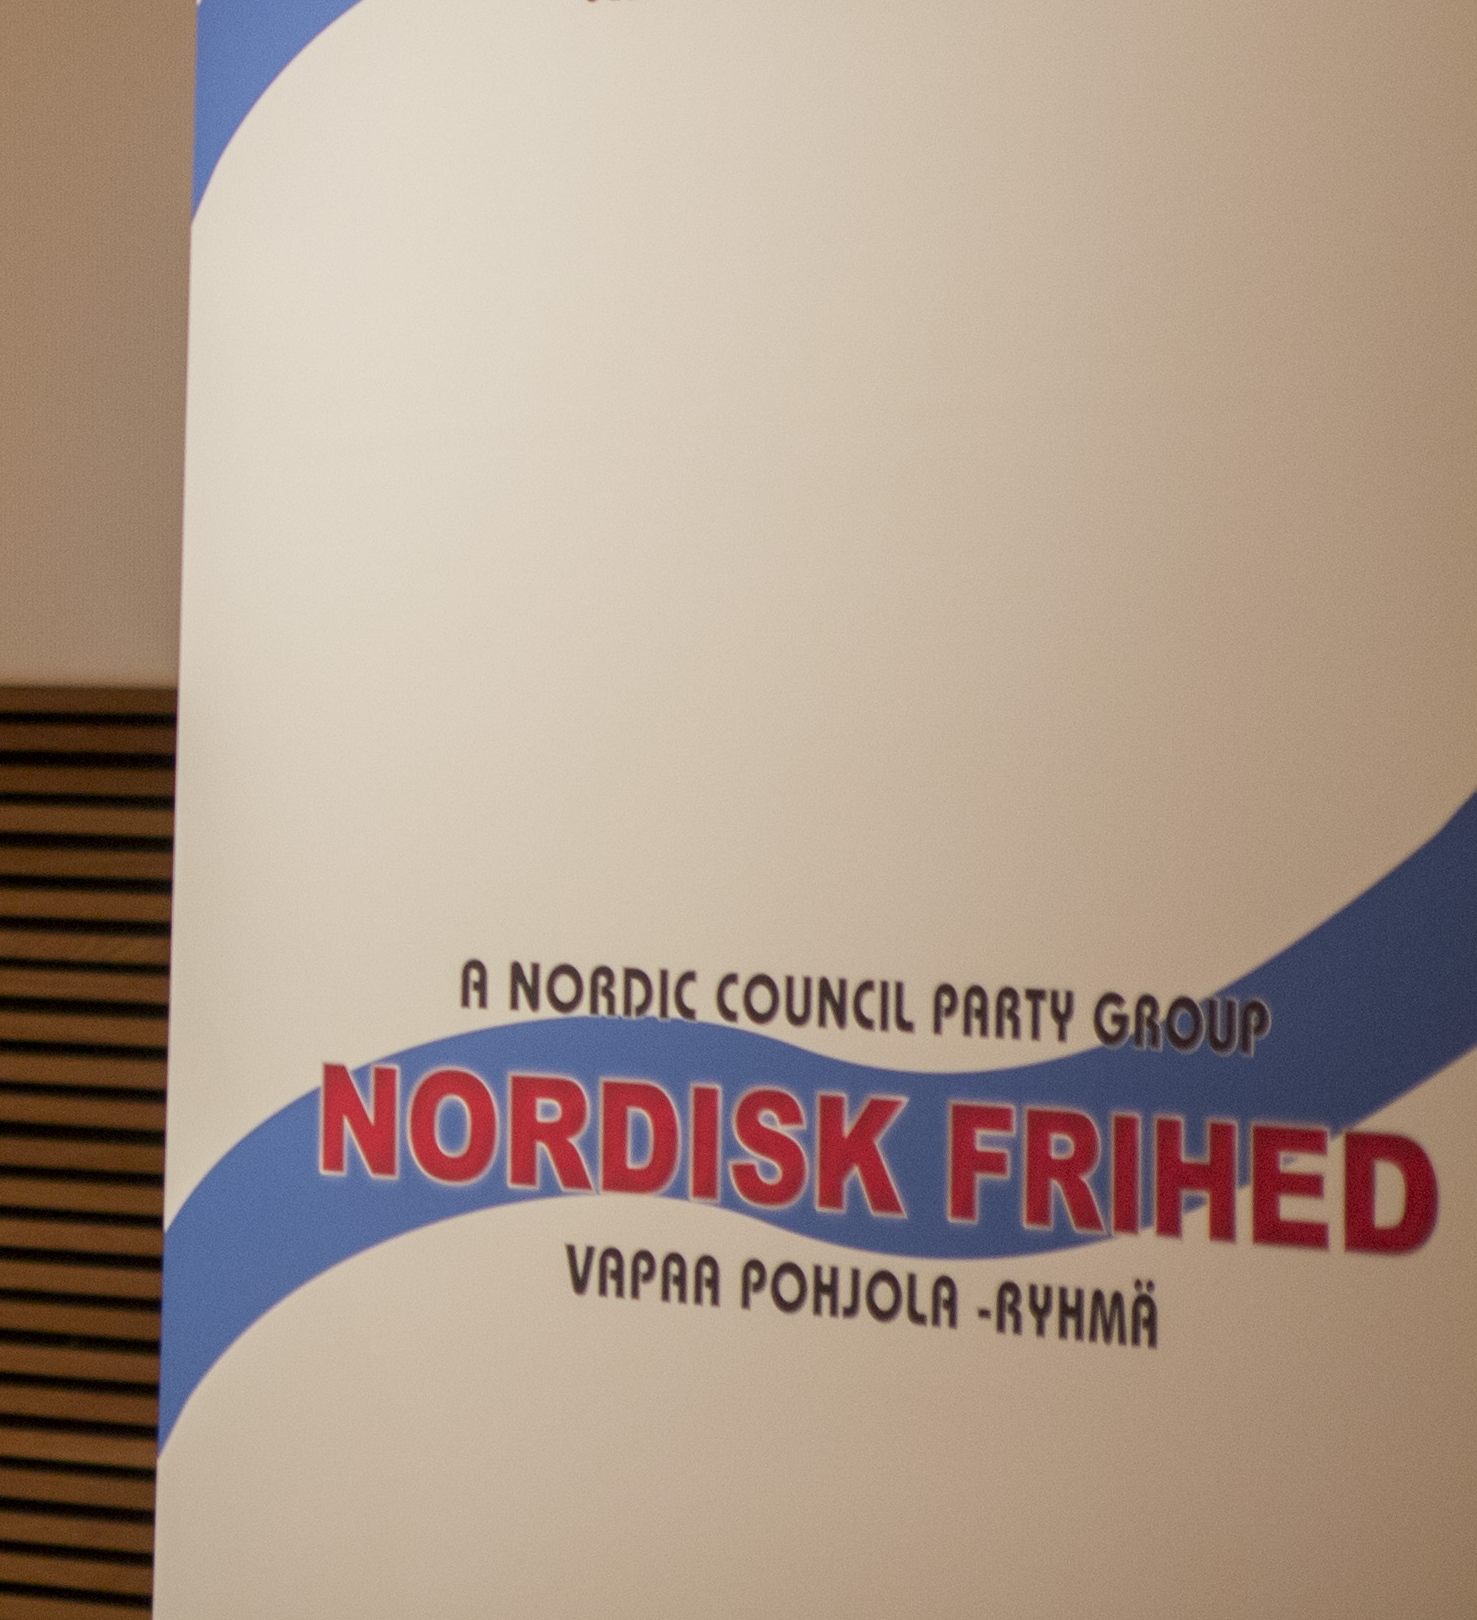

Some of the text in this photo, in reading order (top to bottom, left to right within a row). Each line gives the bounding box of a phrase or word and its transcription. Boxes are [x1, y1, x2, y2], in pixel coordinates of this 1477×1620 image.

[461, 958, 1271, 1056] A NORDIC COUNCIL PARTY GROUP
[319, 1062, 1440, 1256] NORDISK FRIHED
[565, 1244, 1159, 1349] VAPAA POHJOLA -RYHMÄ
